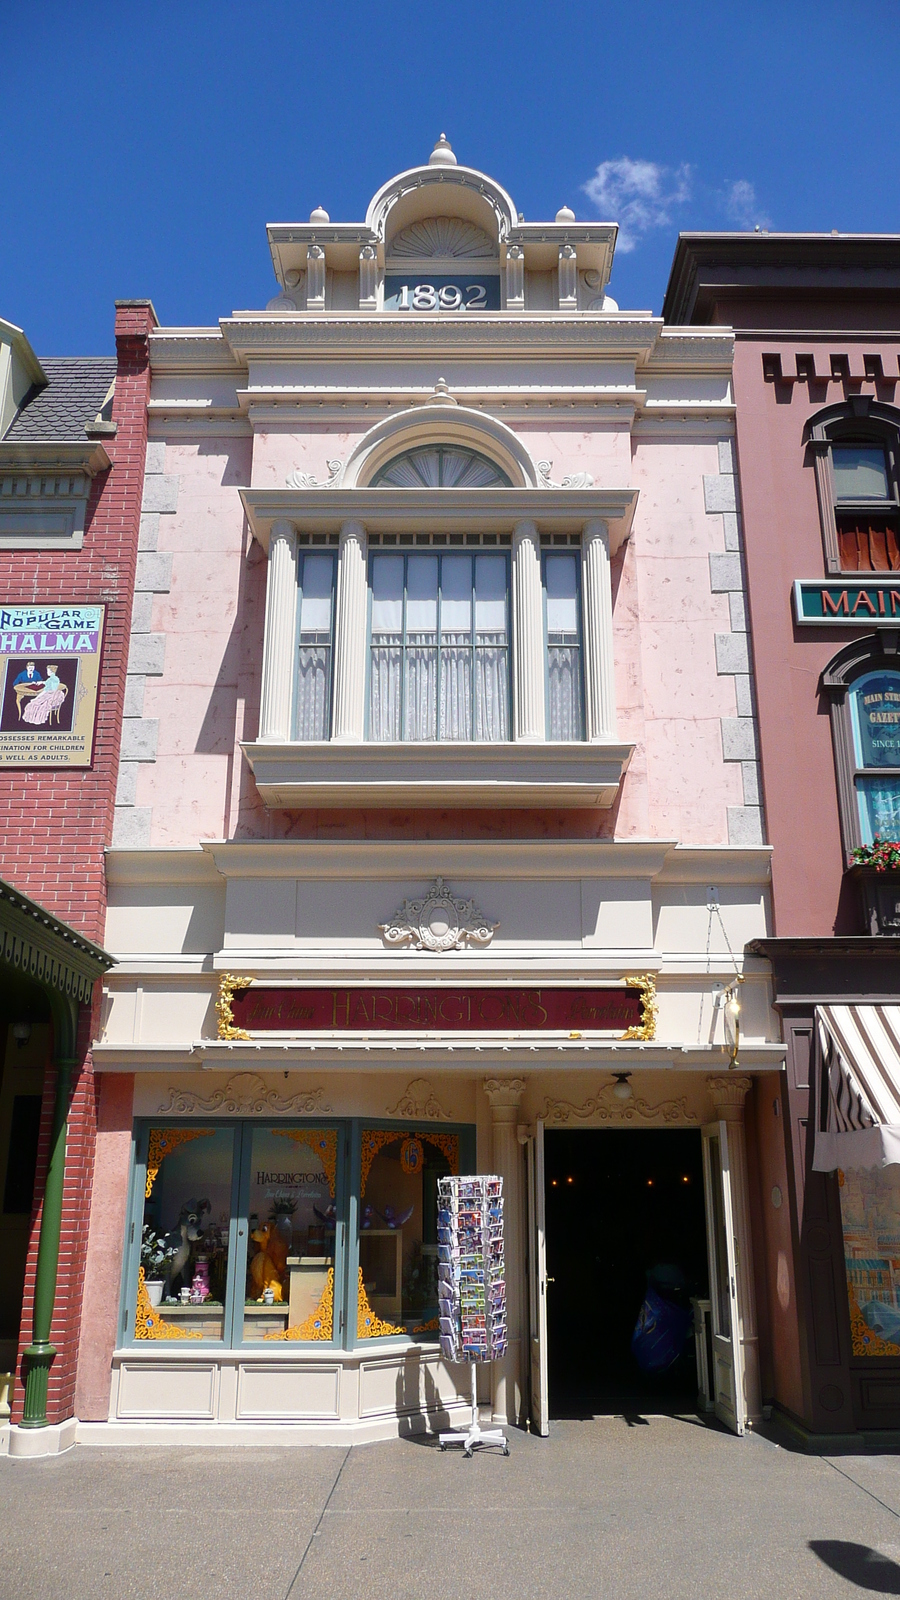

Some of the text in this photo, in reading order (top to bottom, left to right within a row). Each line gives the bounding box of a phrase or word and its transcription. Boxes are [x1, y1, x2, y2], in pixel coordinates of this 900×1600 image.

[399, 284, 488, 309] 1892
[0, 609, 84, 630] POPULAR
[44, 620, 96, 630] GAME
[864, 692, 900, 705] MAIN STR
[872, 740, 895, 748] SINCE
[330, 990, 548, 1027] HARRINGTON'S
